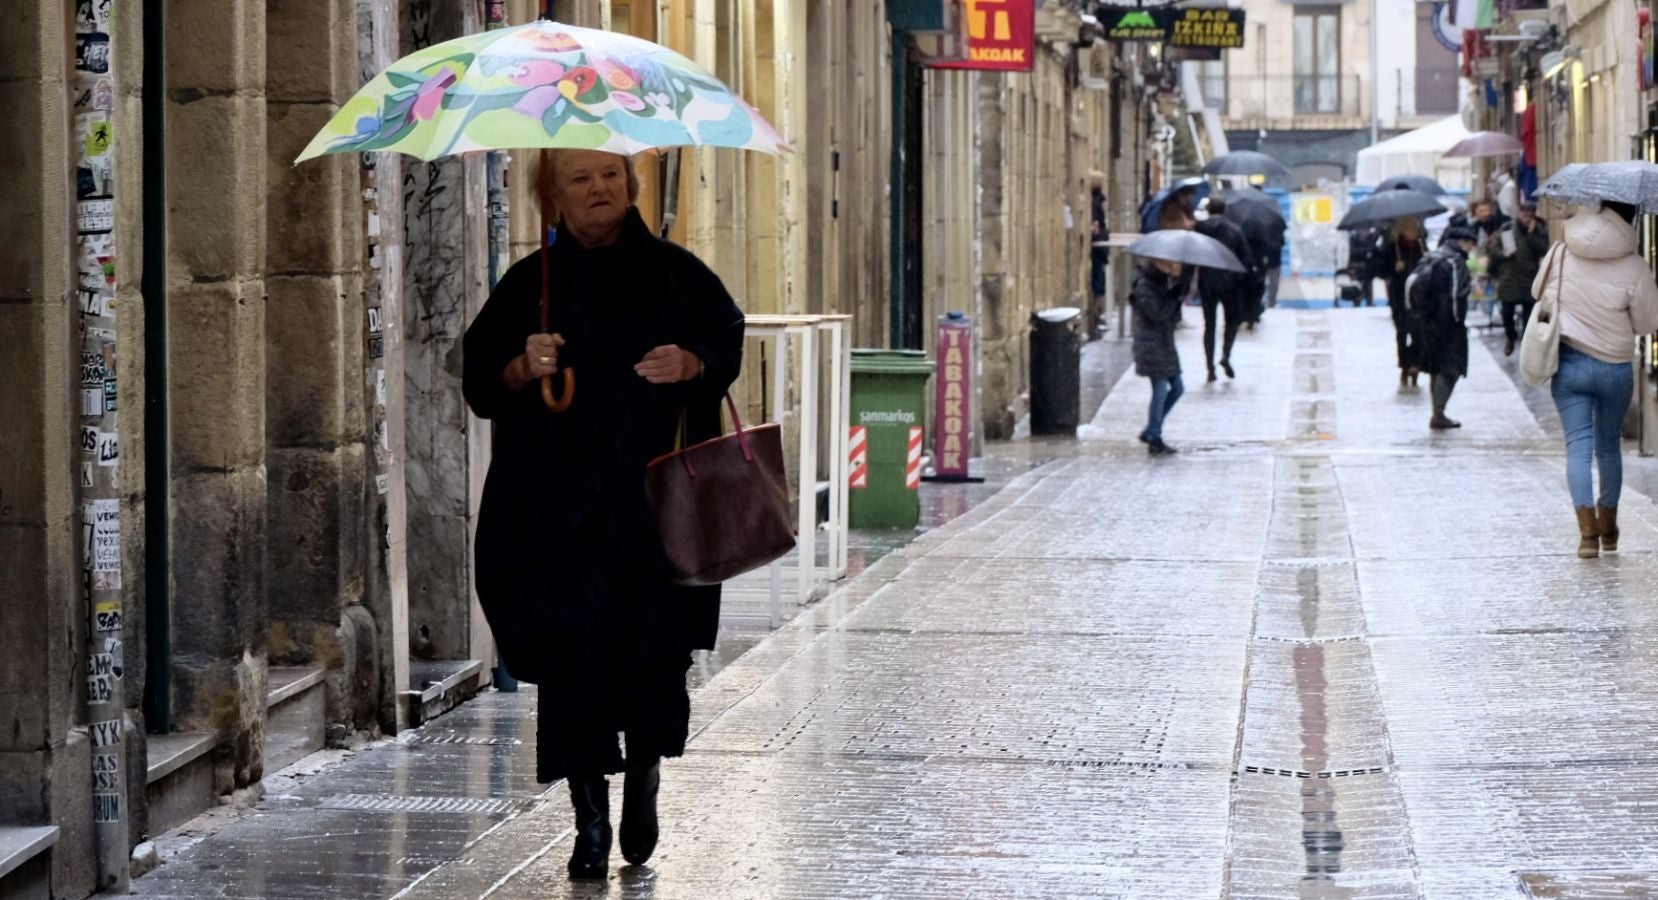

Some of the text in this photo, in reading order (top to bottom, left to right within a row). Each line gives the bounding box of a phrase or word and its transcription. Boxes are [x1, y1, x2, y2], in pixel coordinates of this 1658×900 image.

[1185, 9, 1230, 20] BAR
[1174, 20, 1238, 35] IZKINA
[943, 329, 963, 469] TABAKOAK
[860, 409, 915, 424] sanmarkos
